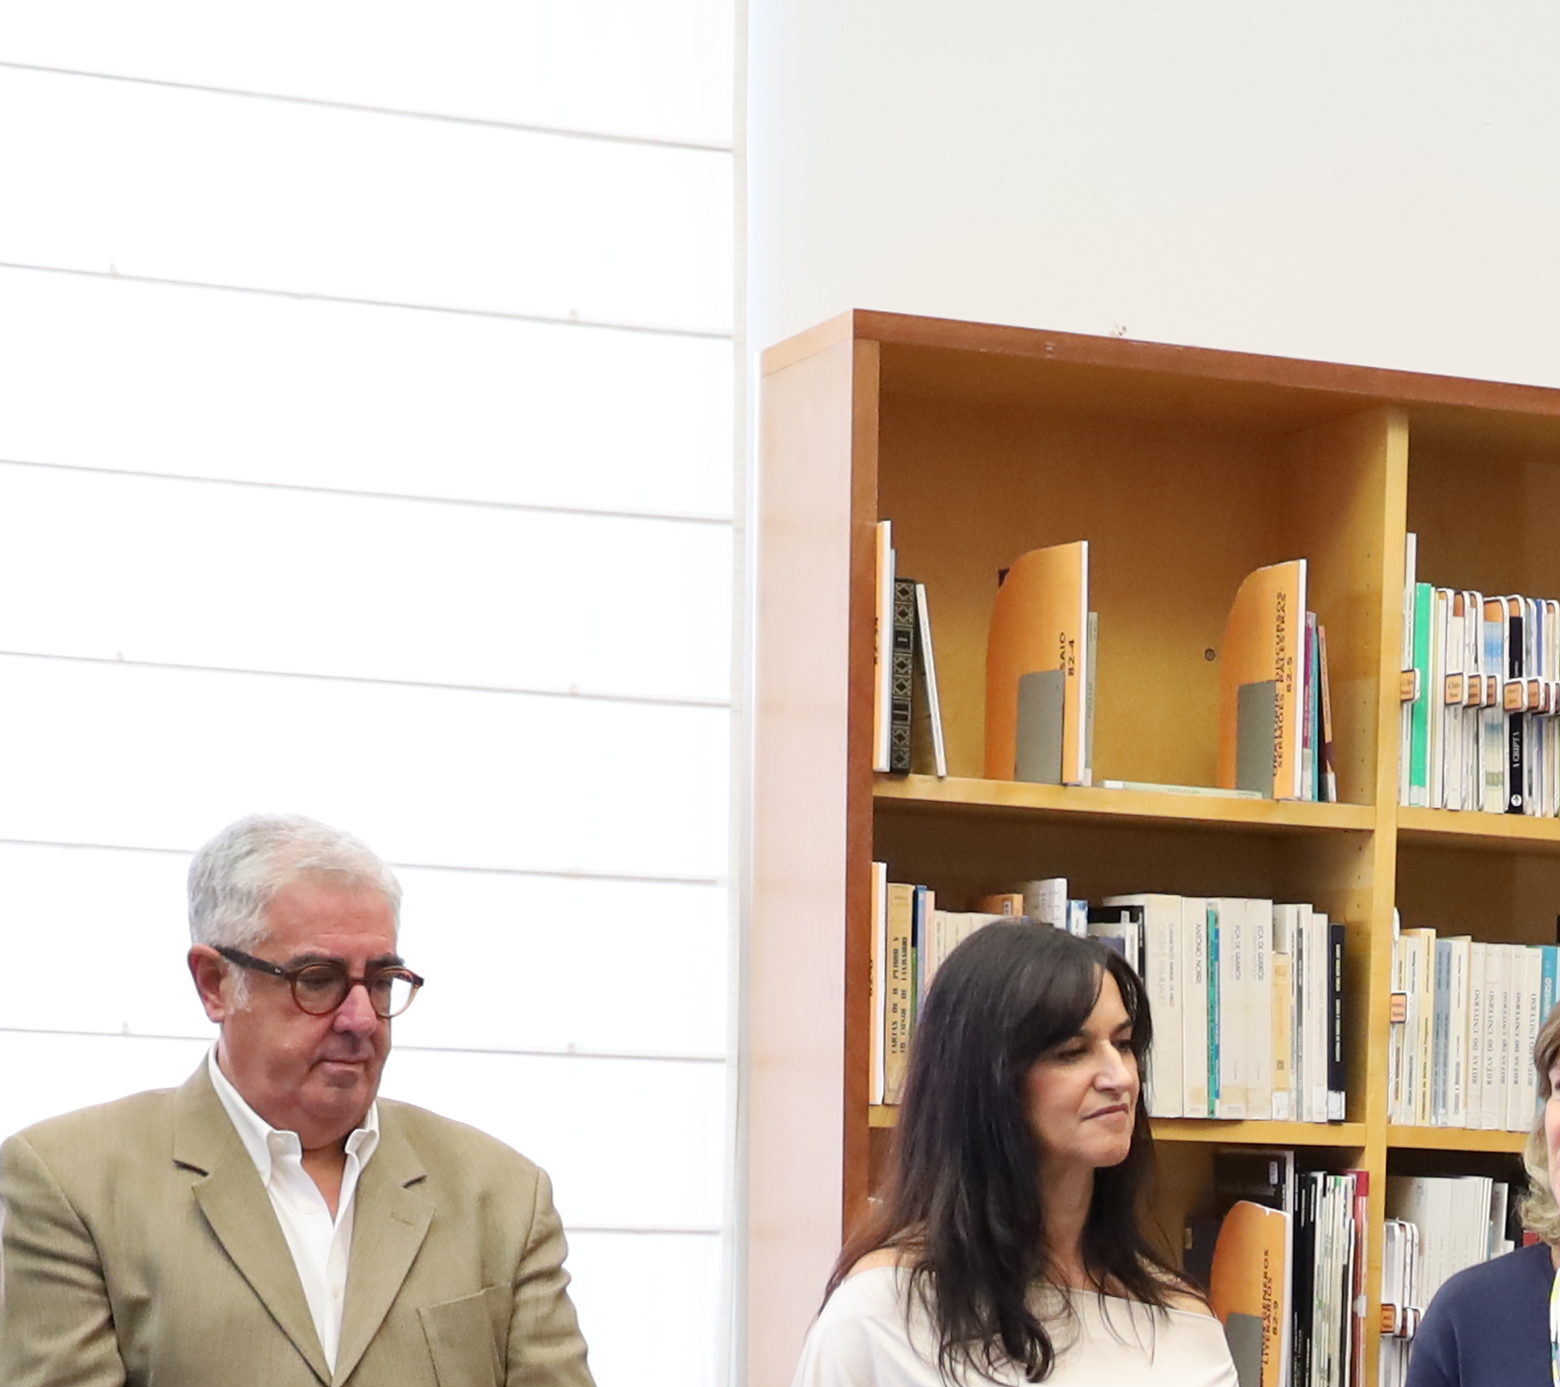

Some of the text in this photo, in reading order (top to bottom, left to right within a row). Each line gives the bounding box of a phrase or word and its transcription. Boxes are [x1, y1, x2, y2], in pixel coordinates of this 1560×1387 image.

[1194, 923, 1204, 984] ANTÓNIO NOBRE
[1234, 925, 1242, 950] EÇA DE
[1256, 925, 1265, 981] EÇA DE QUEIRÓS
[1486, 990, 1495, 1036] UNIVERSO
[1514, 990, 1522, 1036] UNIVERSO
[1471, 989, 1480, 1085] ROTAS DO UNIVERSO
[1486, 1039, 1494, 1052] DO
[1501, 1039, 1508, 1052] DO
[1514, 1039, 1520, 1052] DO
[1527, 993, 1536, 1086] ROTAS DO UNIVERSO
